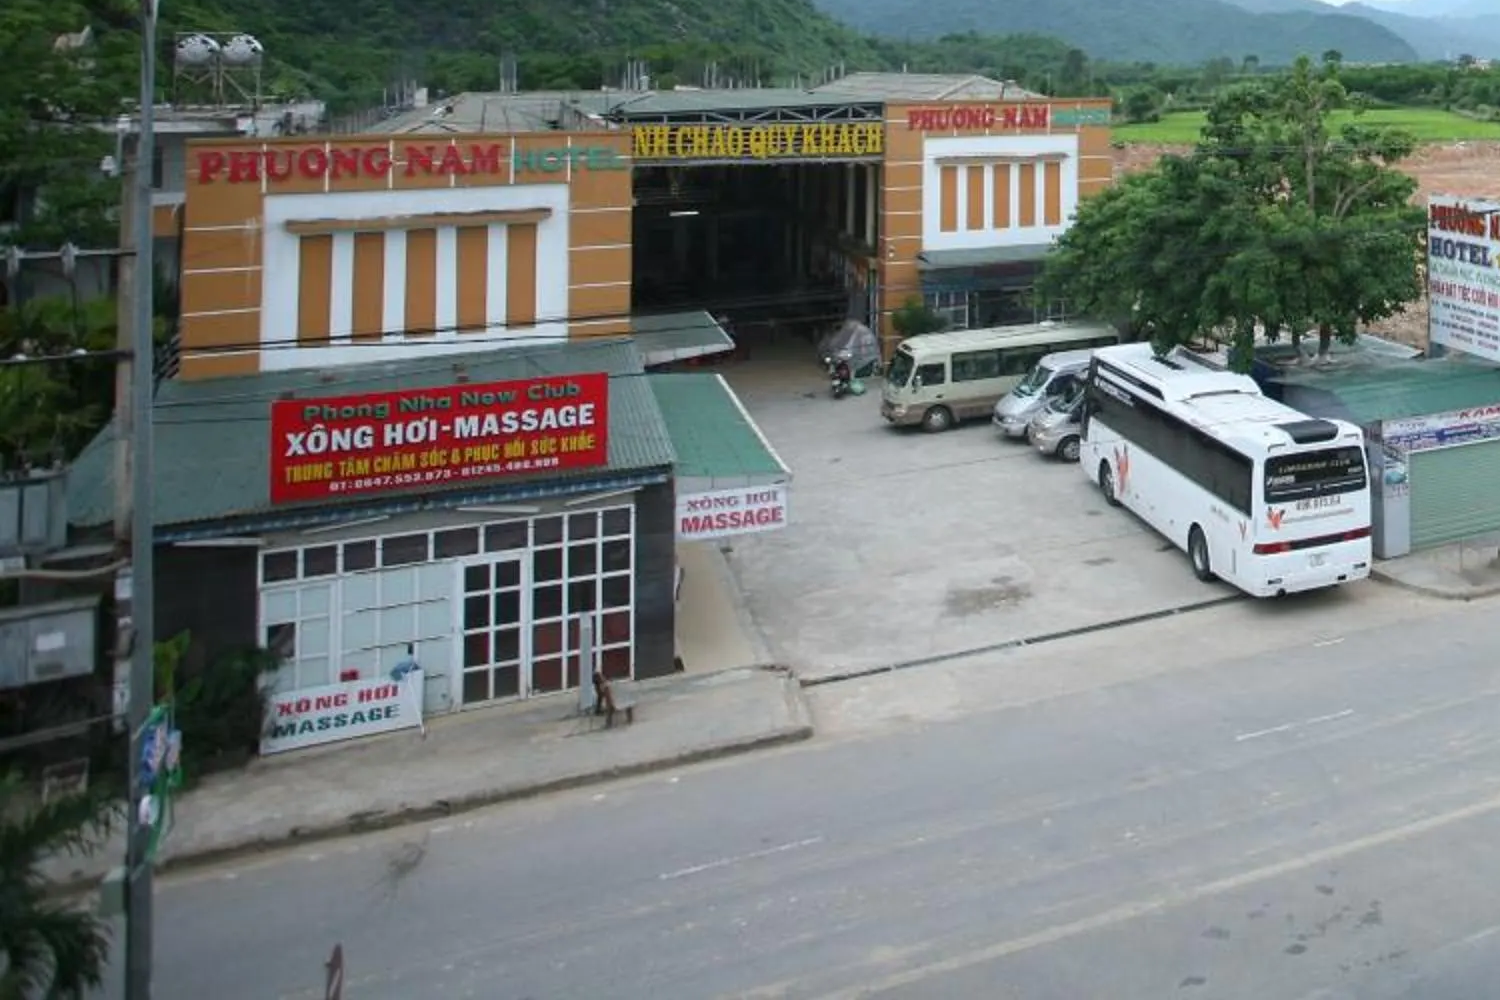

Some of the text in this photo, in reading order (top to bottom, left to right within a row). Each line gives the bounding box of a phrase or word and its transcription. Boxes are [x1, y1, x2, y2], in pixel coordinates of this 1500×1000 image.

[1004, 104, 1049, 128] NAM
[404, 143, 503, 178] NAM
[513, 144, 627, 173] HOTEL
[1430, 236, 1492, 268] HOTEL
[303, 379, 581, 421] Phong Nha New Club
[285, 424, 373, 457] XÔNG
[681, 506, 784, 533] MASSAGE
[271, 703, 400, 739] MASSAGE
